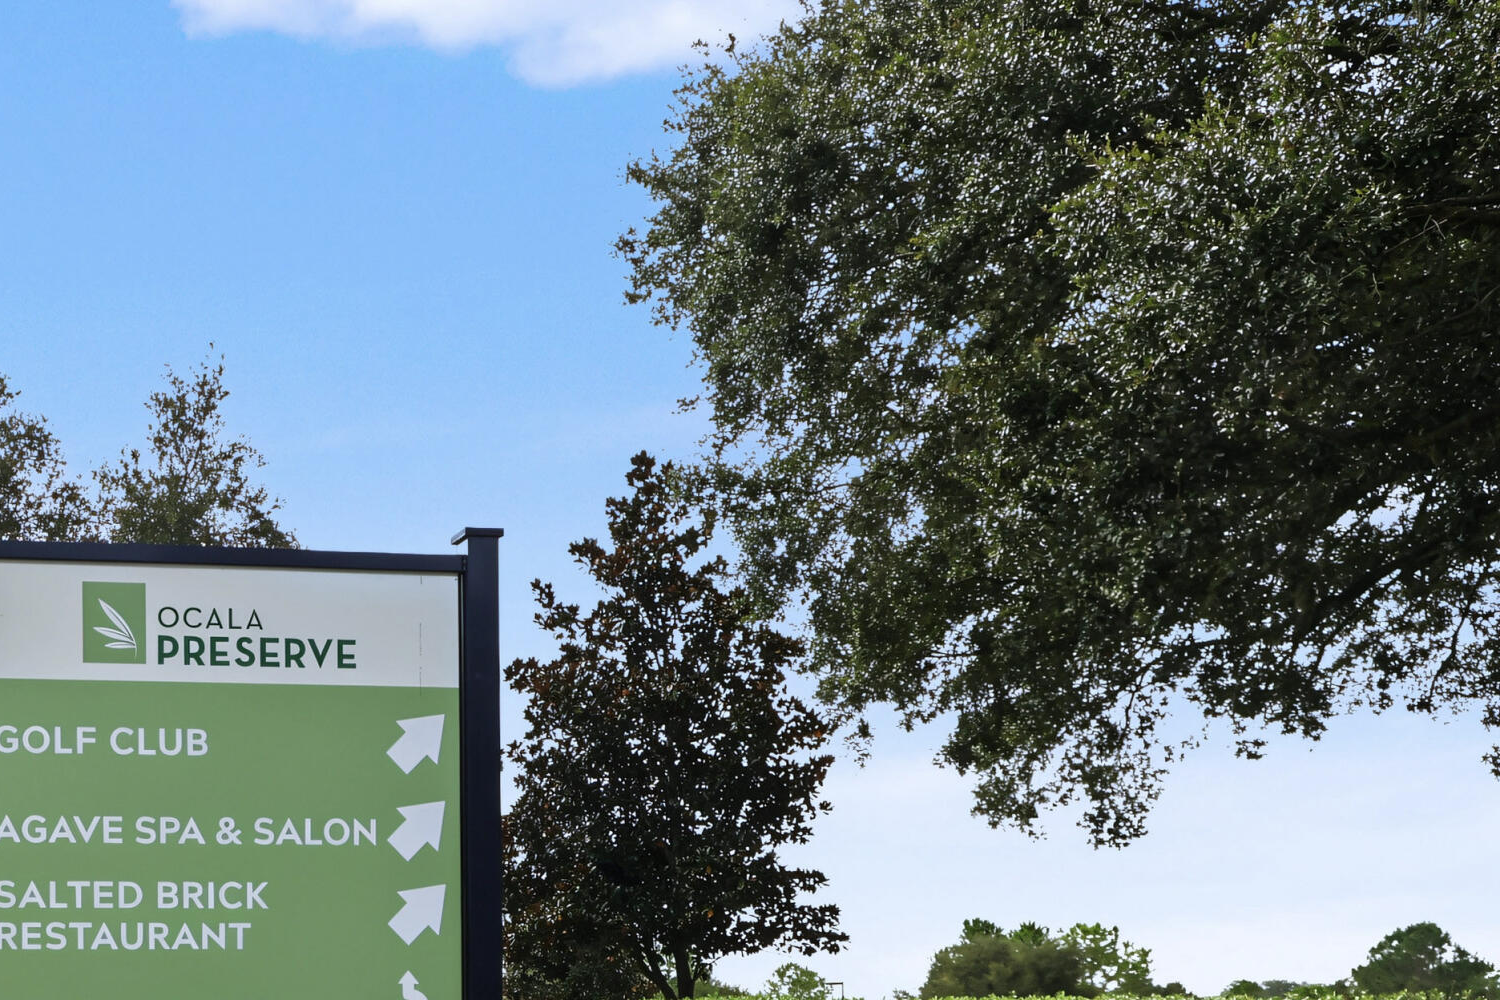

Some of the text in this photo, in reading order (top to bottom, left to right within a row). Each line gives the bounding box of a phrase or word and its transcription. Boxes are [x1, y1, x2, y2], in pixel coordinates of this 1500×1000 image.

[158, 607, 263, 630] OCALA
[158, 635, 356, 669] PRESERVE
[110, 727, 208, 756] CLUB
[136, 816, 206, 844] SPA
[216, 817, 242, 844] &
[254, 817, 376, 845] SALON
[158, 881, 268, 909] BRICK
